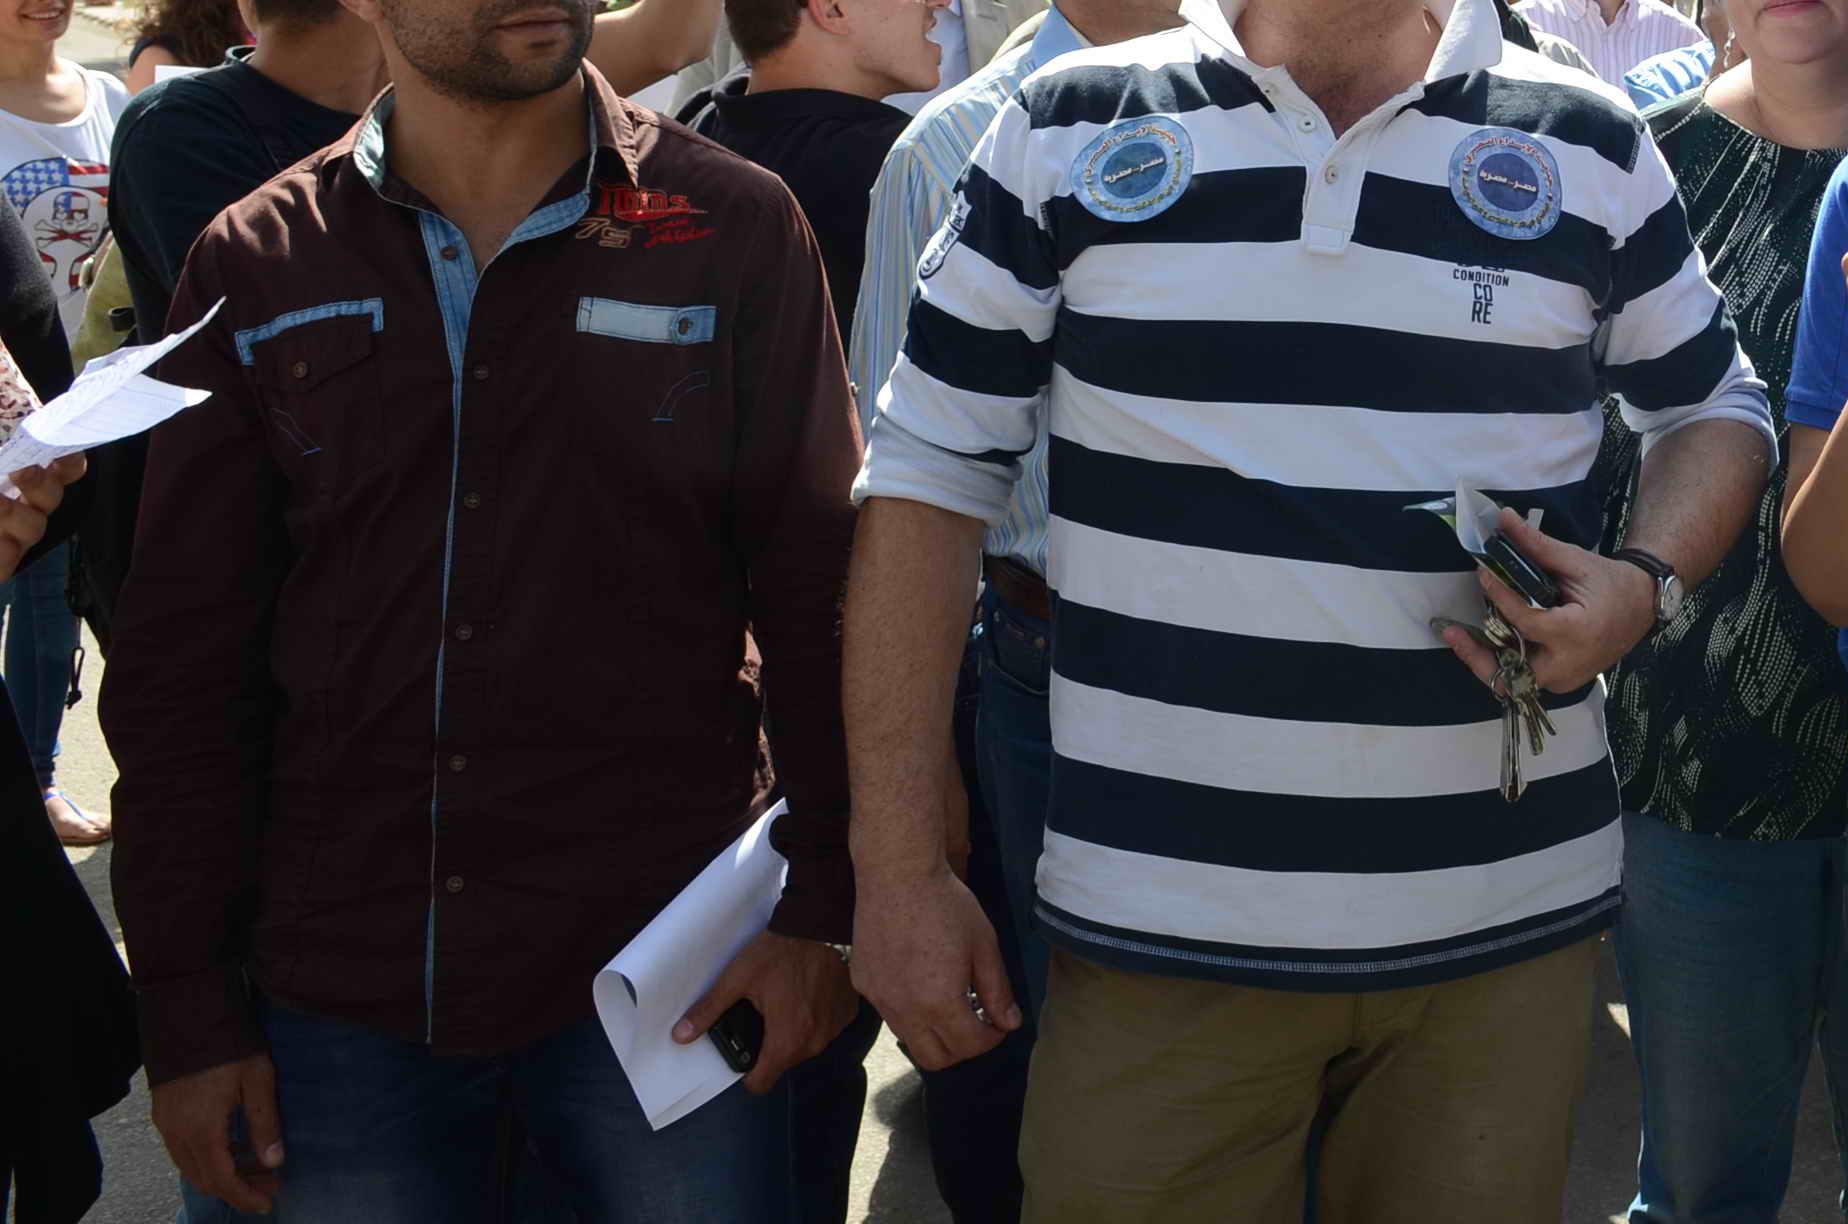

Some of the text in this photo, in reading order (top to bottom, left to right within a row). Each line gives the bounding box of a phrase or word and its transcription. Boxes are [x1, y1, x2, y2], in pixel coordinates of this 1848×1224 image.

[1453, 268, 1510, 287] CONDITION
[1473, 283, 1493, 302] CO
[1471, 300, 1494, 324] RE
